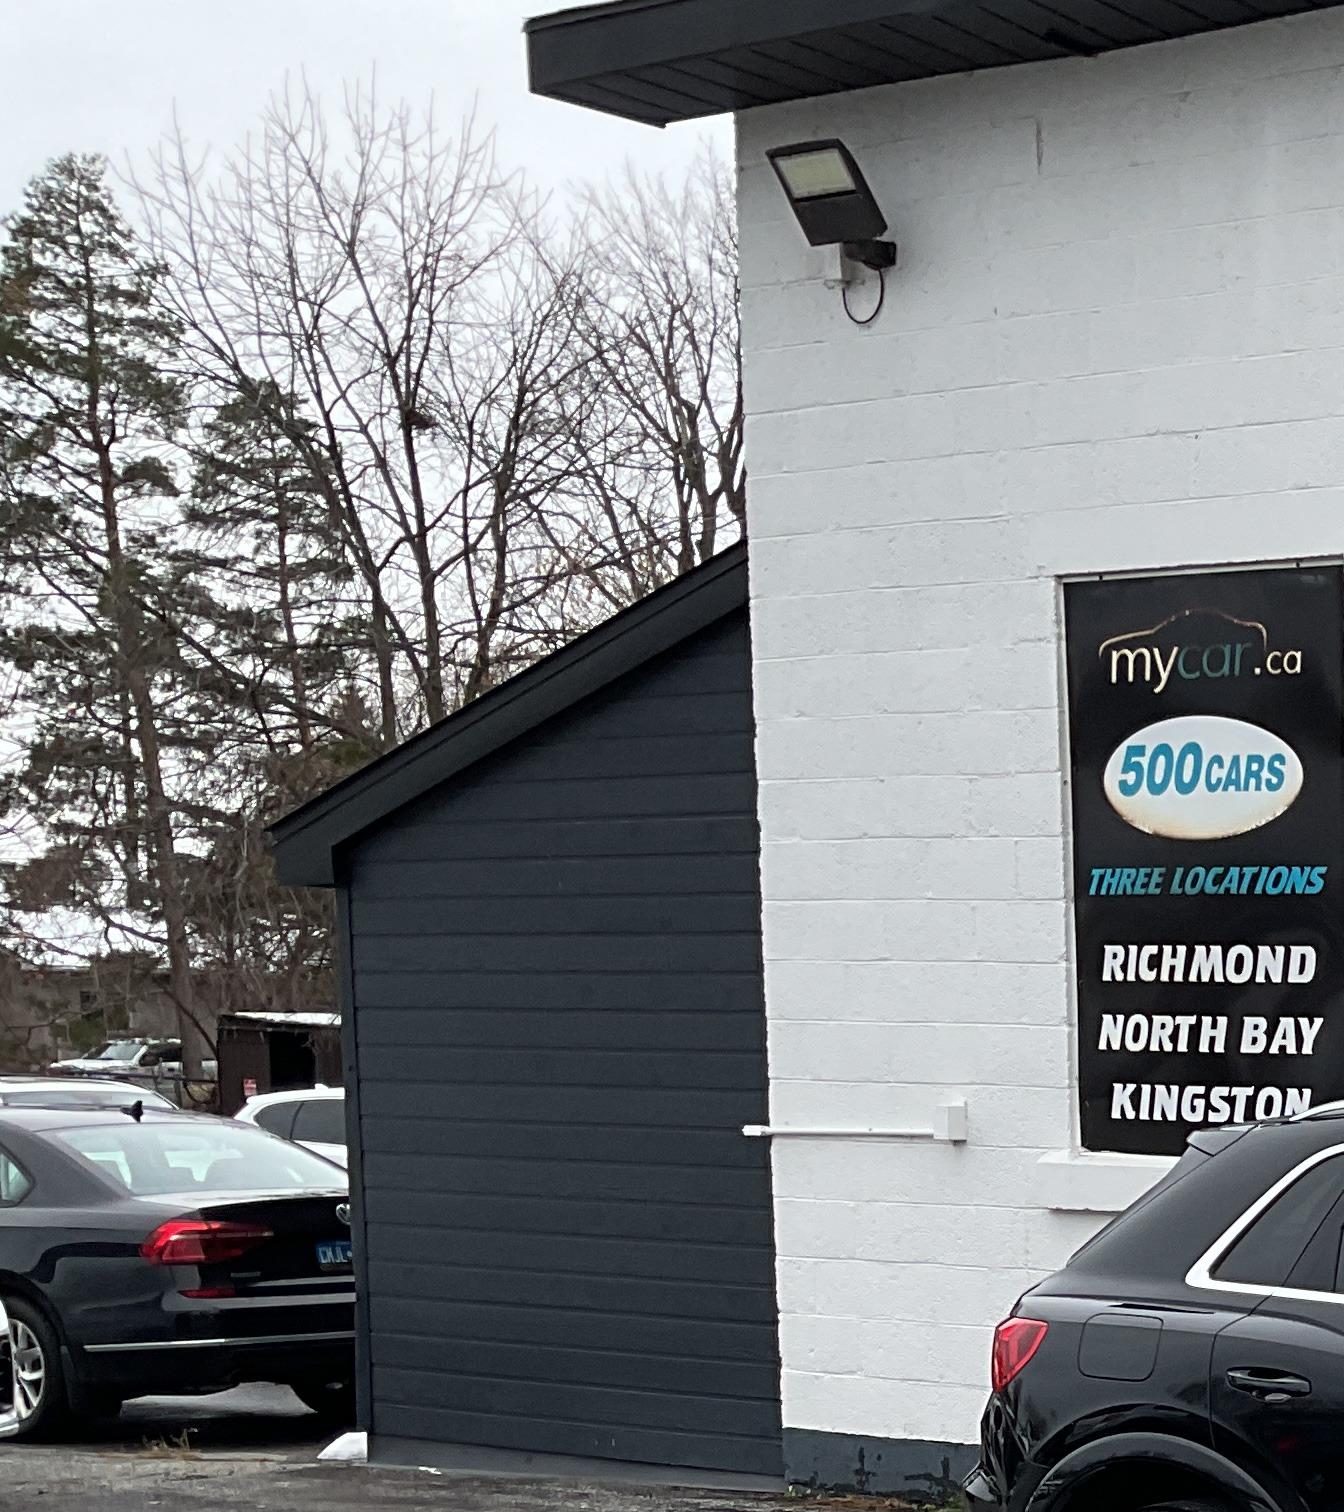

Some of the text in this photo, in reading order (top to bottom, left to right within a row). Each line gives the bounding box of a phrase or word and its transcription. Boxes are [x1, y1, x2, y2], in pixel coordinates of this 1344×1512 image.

[1111, 641, 1303, 695] mycar.ca
[1118, 741, 1287, 797] 500 CARS
[1088, 865, 1328, 896] THREE LOCATIONS
[1102, 944, 1317, 984] RICHMOND
[1098, 1012, 1324, 1055] NORTH BAY
[1111, 1082, 1312, 1124] KINGSTON
